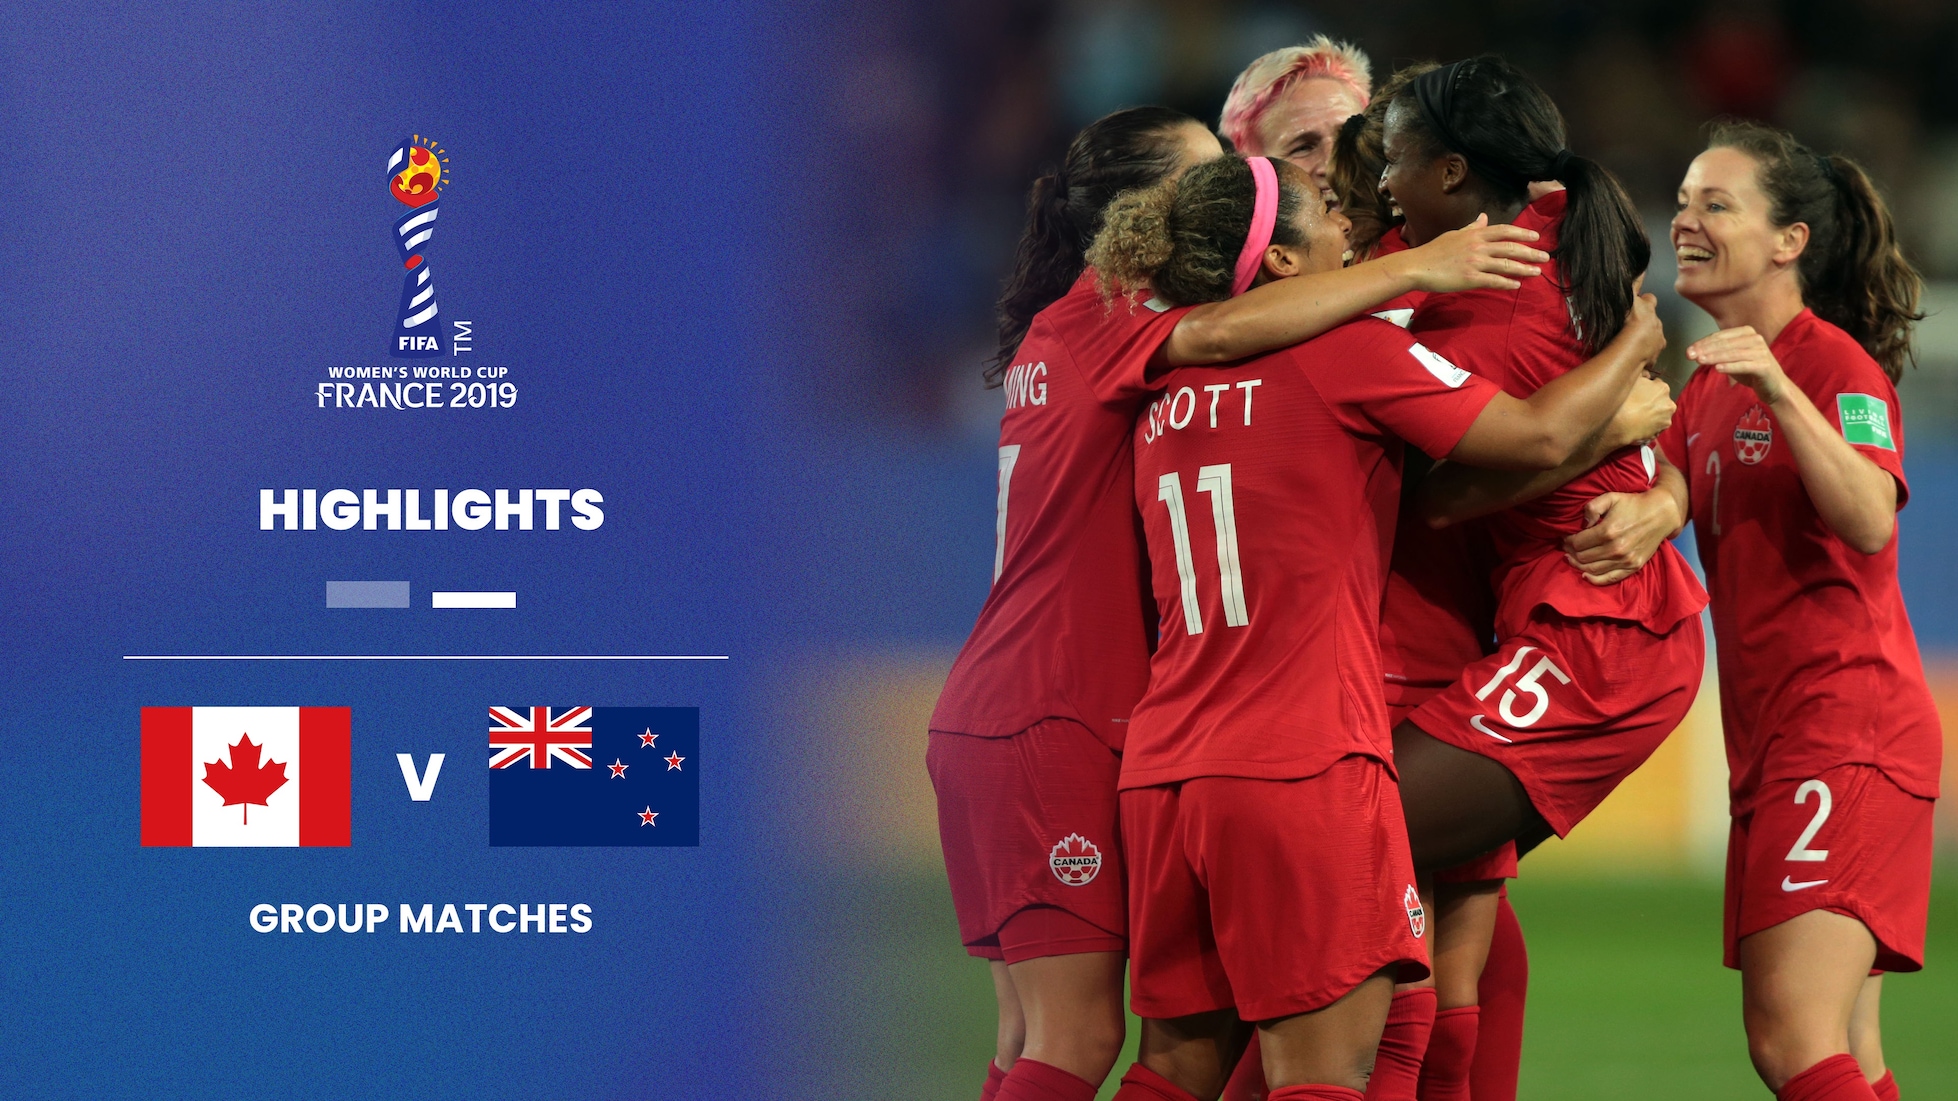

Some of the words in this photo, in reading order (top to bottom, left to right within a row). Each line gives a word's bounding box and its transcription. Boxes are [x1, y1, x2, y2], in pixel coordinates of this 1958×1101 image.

[1144, 379, 1262, 444] SCOTT
[1734, 430, 1771, 442] CANADA
[1157, 463, 1250, 636] 11
[1474, 645, 1572, 728] 15
[1784, 779, 1833, 862] 2
[1053, 857, 1098, 866] CANADA
